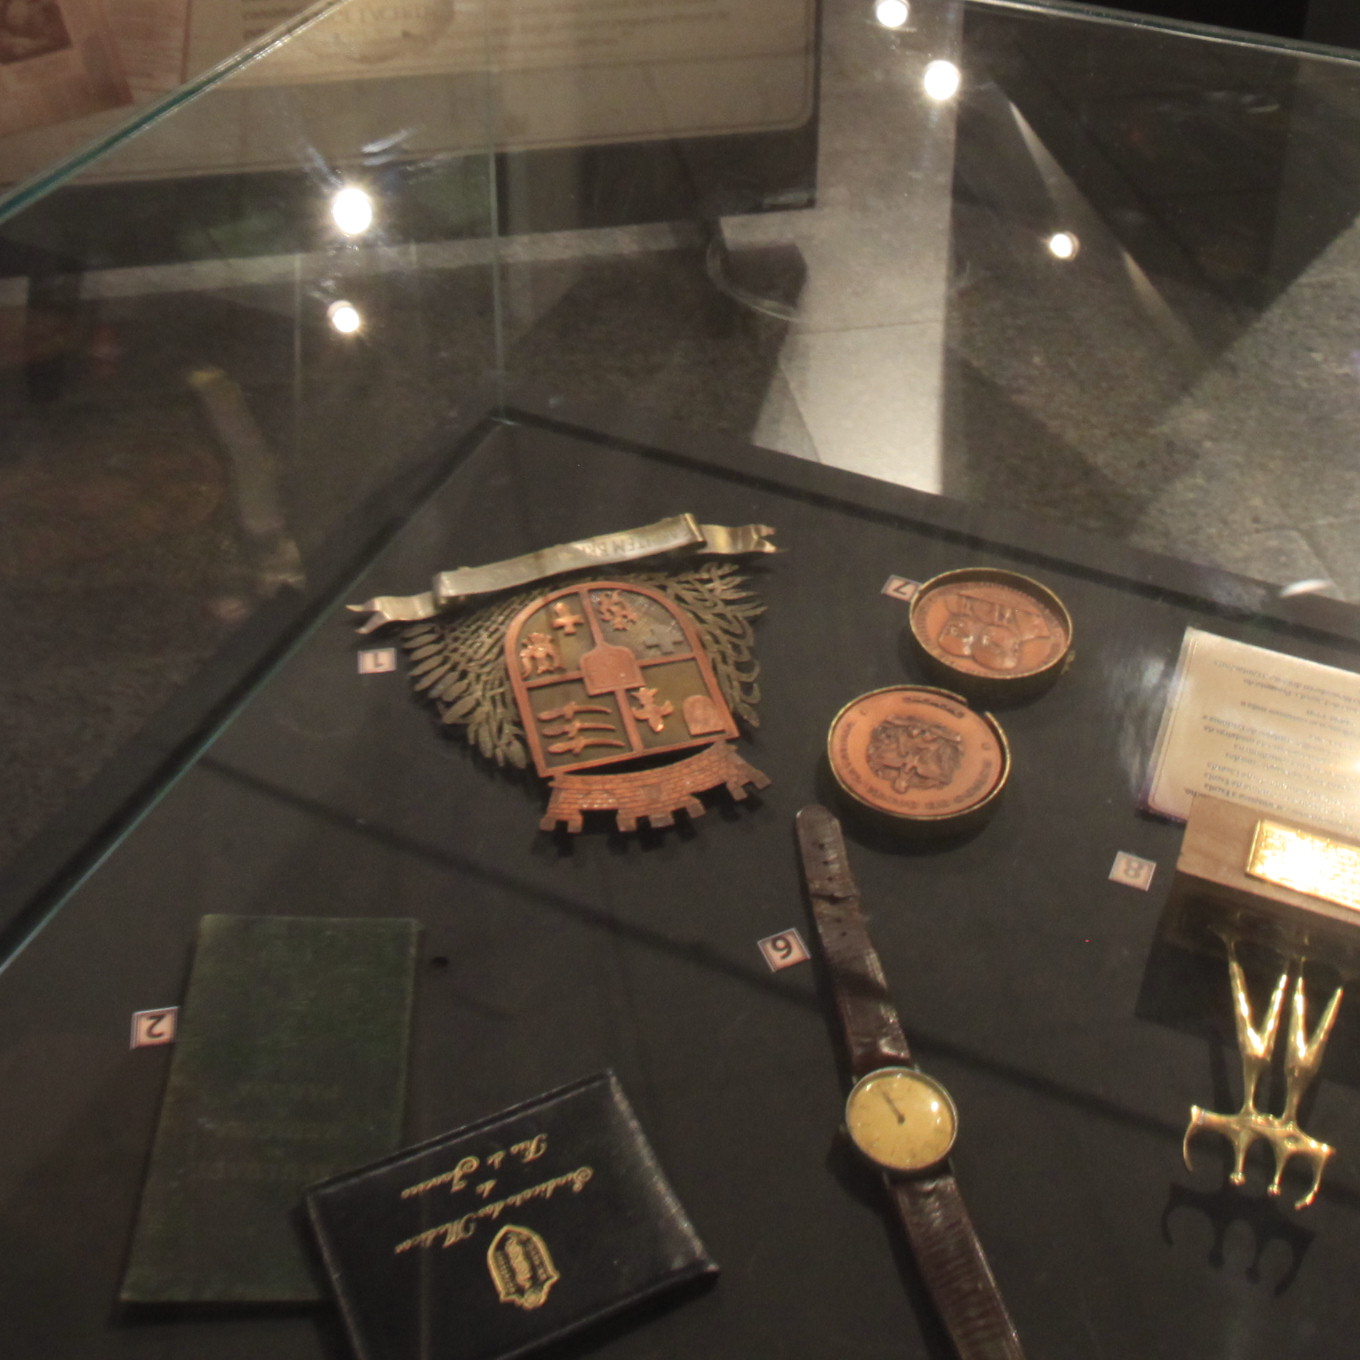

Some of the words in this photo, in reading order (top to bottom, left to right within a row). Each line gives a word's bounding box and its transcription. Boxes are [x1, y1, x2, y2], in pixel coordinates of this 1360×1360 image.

[892, 580, 911, 596] 7
[372, 651, 386, 669] 1
[1124, 860, 1142, 880] 8
[144, 1013, 167, 1040] 2
[486, 1150, 504, 1168] de
[504, 1166, 592, 1206] Sindicato
